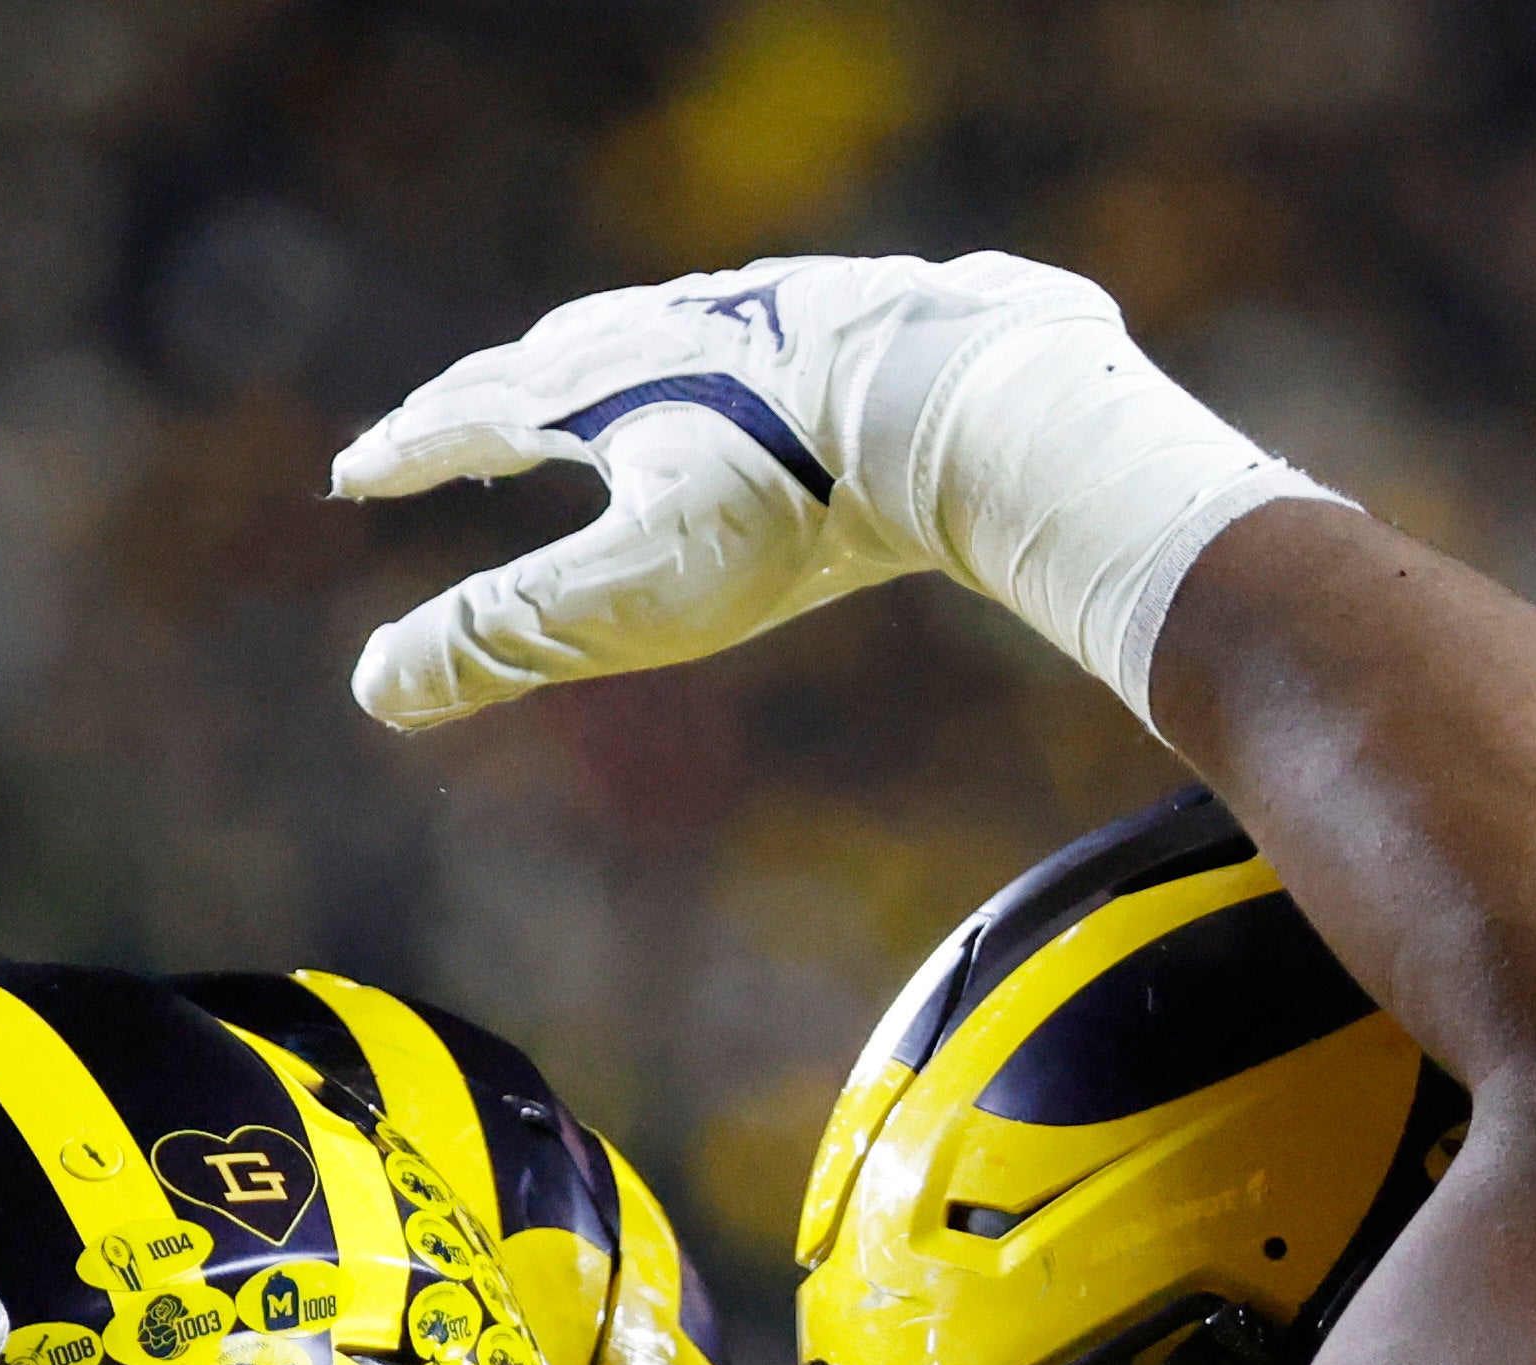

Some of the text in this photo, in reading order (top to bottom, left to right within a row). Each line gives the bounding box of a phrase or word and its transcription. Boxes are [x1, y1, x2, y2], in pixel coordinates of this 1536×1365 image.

[203, 1152, 288, 1202] G
[145, 1232, 195, 1262] 1004
[267, 1293, 294, 1318] M
[303, 1295, 338, 1322] 1008
[176, 1309, 222, 1343] 1003
[448, 1315, 472, 1341] 972
